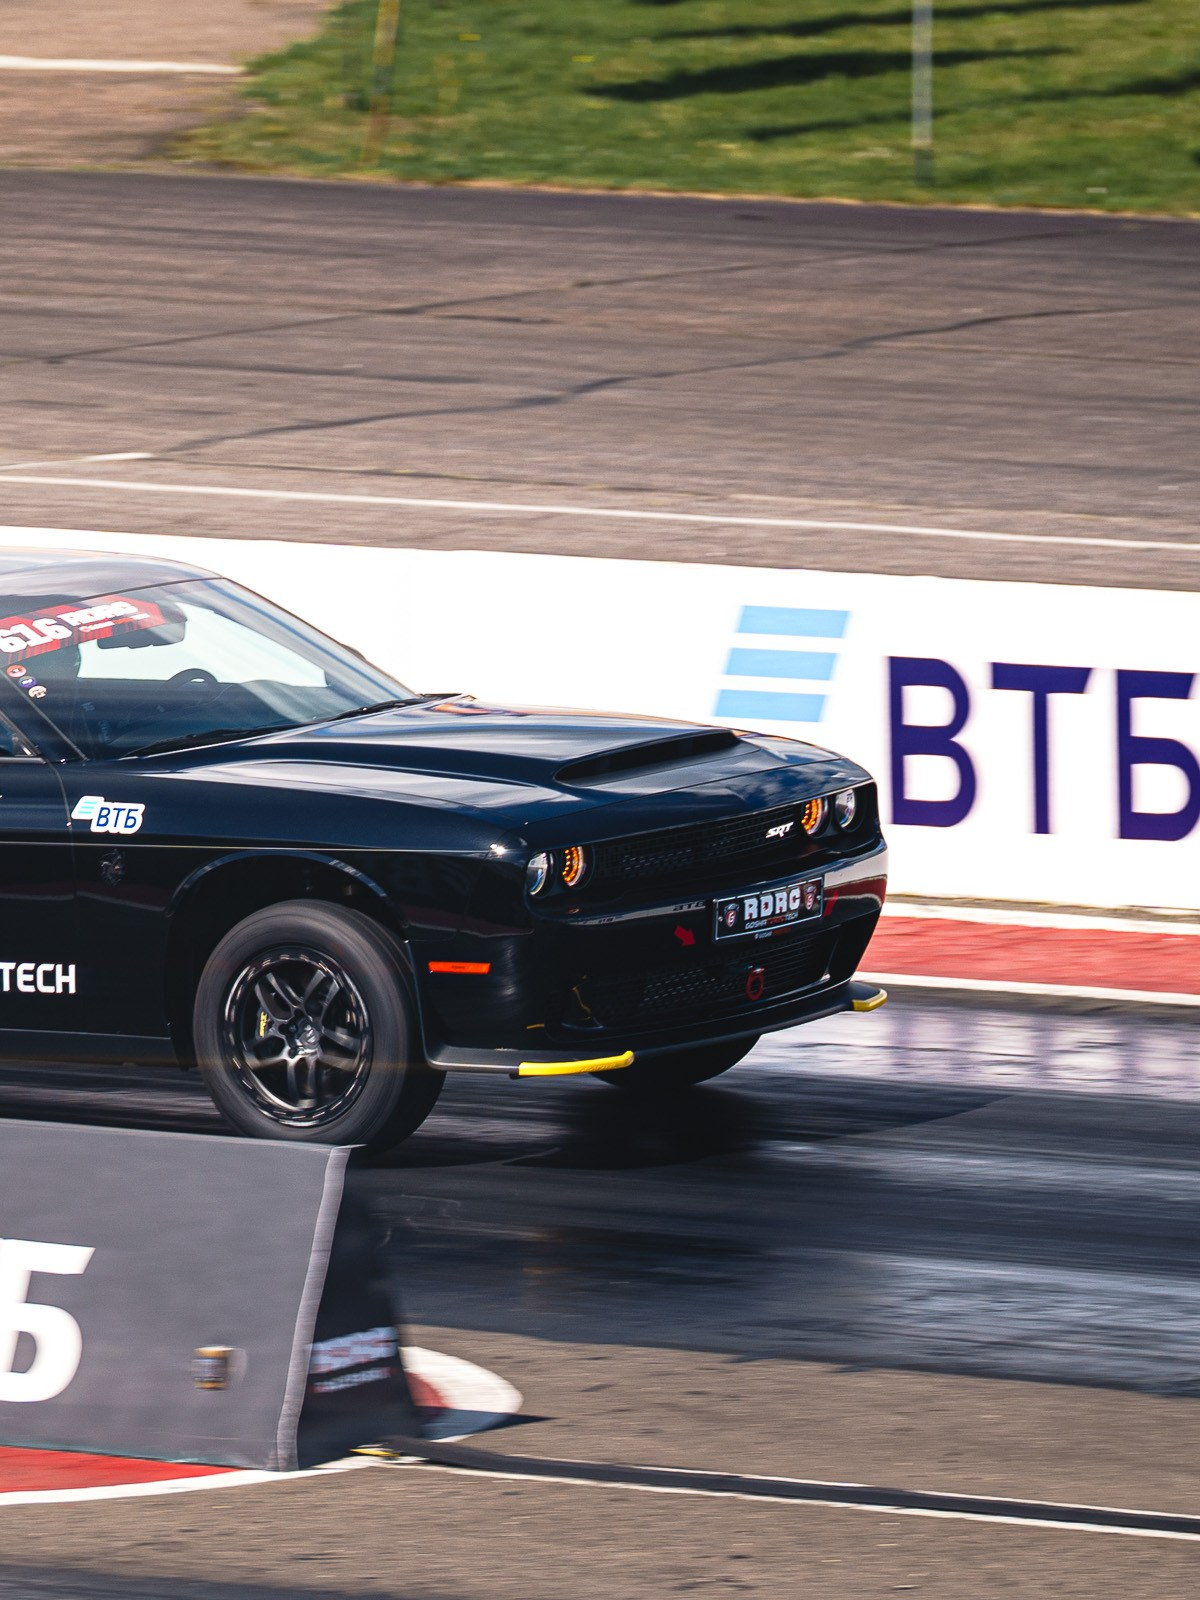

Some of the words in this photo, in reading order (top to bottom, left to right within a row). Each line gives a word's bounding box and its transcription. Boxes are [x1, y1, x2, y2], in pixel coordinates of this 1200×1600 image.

[886, 656, 1200, 842] ВТБ
[96, 806, 139, 829] ВТБ
[765, 822, 794, 838] SRT
[744, 887, 800, 920] RDRC
